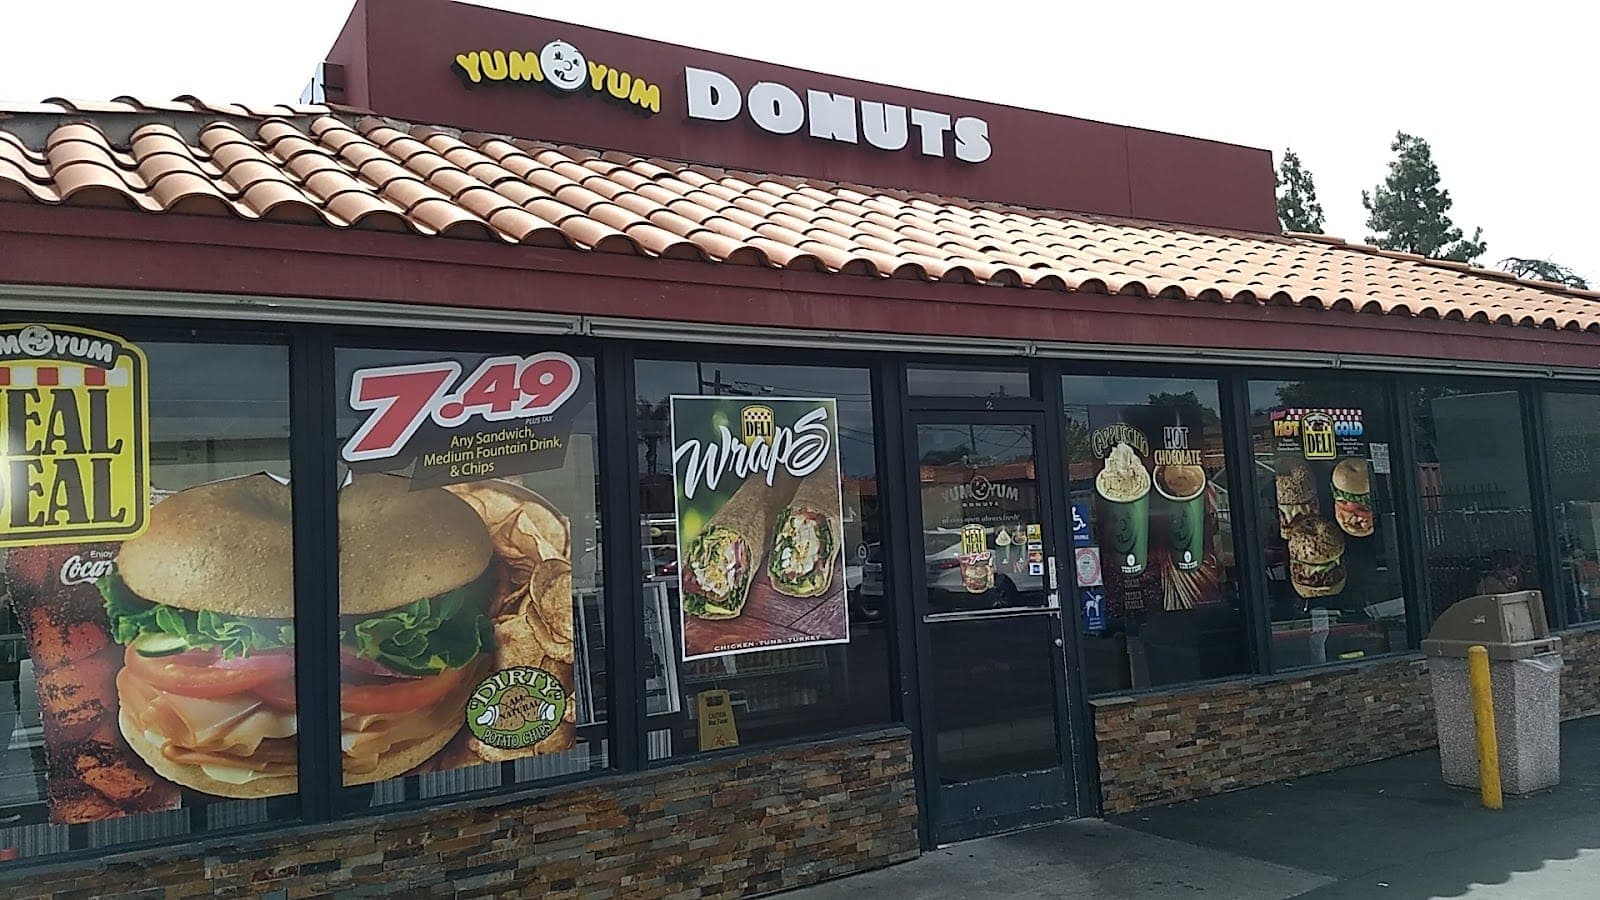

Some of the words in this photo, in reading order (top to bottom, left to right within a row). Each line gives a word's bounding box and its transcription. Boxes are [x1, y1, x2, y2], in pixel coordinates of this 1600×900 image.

[456, 50, 545, 83] YUM
[588, 60, 661, 113] YUM
[684, 66, 992, 164] DONUTS
[55, 334, 114, 363] YUM
[349, 356, 577, 456] 7.49
[0, 387, 123, 457] EAL
[745, 421, 772, 437] DELI
[1274, 420, 1300, 437] HOT
[1334, 420, 1364, 437] COLD
[450, 435, 475, 449] Any
[476, 426, 536, 445] Sandwich,
[1163, 426, 1189, 449] HOT
[1307, 433, 1333, 453] DELI
[423, 450, 475, 467] Medium
[476, 442, 528, 459] Fountain
[529, 435, 563, 452] Drink,
[673, 406, 832, 500] Wraps
[1154, 449, 1203, 466] CHOCOLATE
[450, 465, 460, 477] &
[461, 461, 495, 475] Chips
[0, 457, 126, 528] EAL
[989, 483, 1018, 501] YUM
[90, 550, 113, 559] Enjoy
[714, 642, 754, 651] CHICKEN
[788, 635, 820, 643] TURKEY
[483, 730, 519, 747] POTATO
[522, 723, 552, 744] CHIPS
